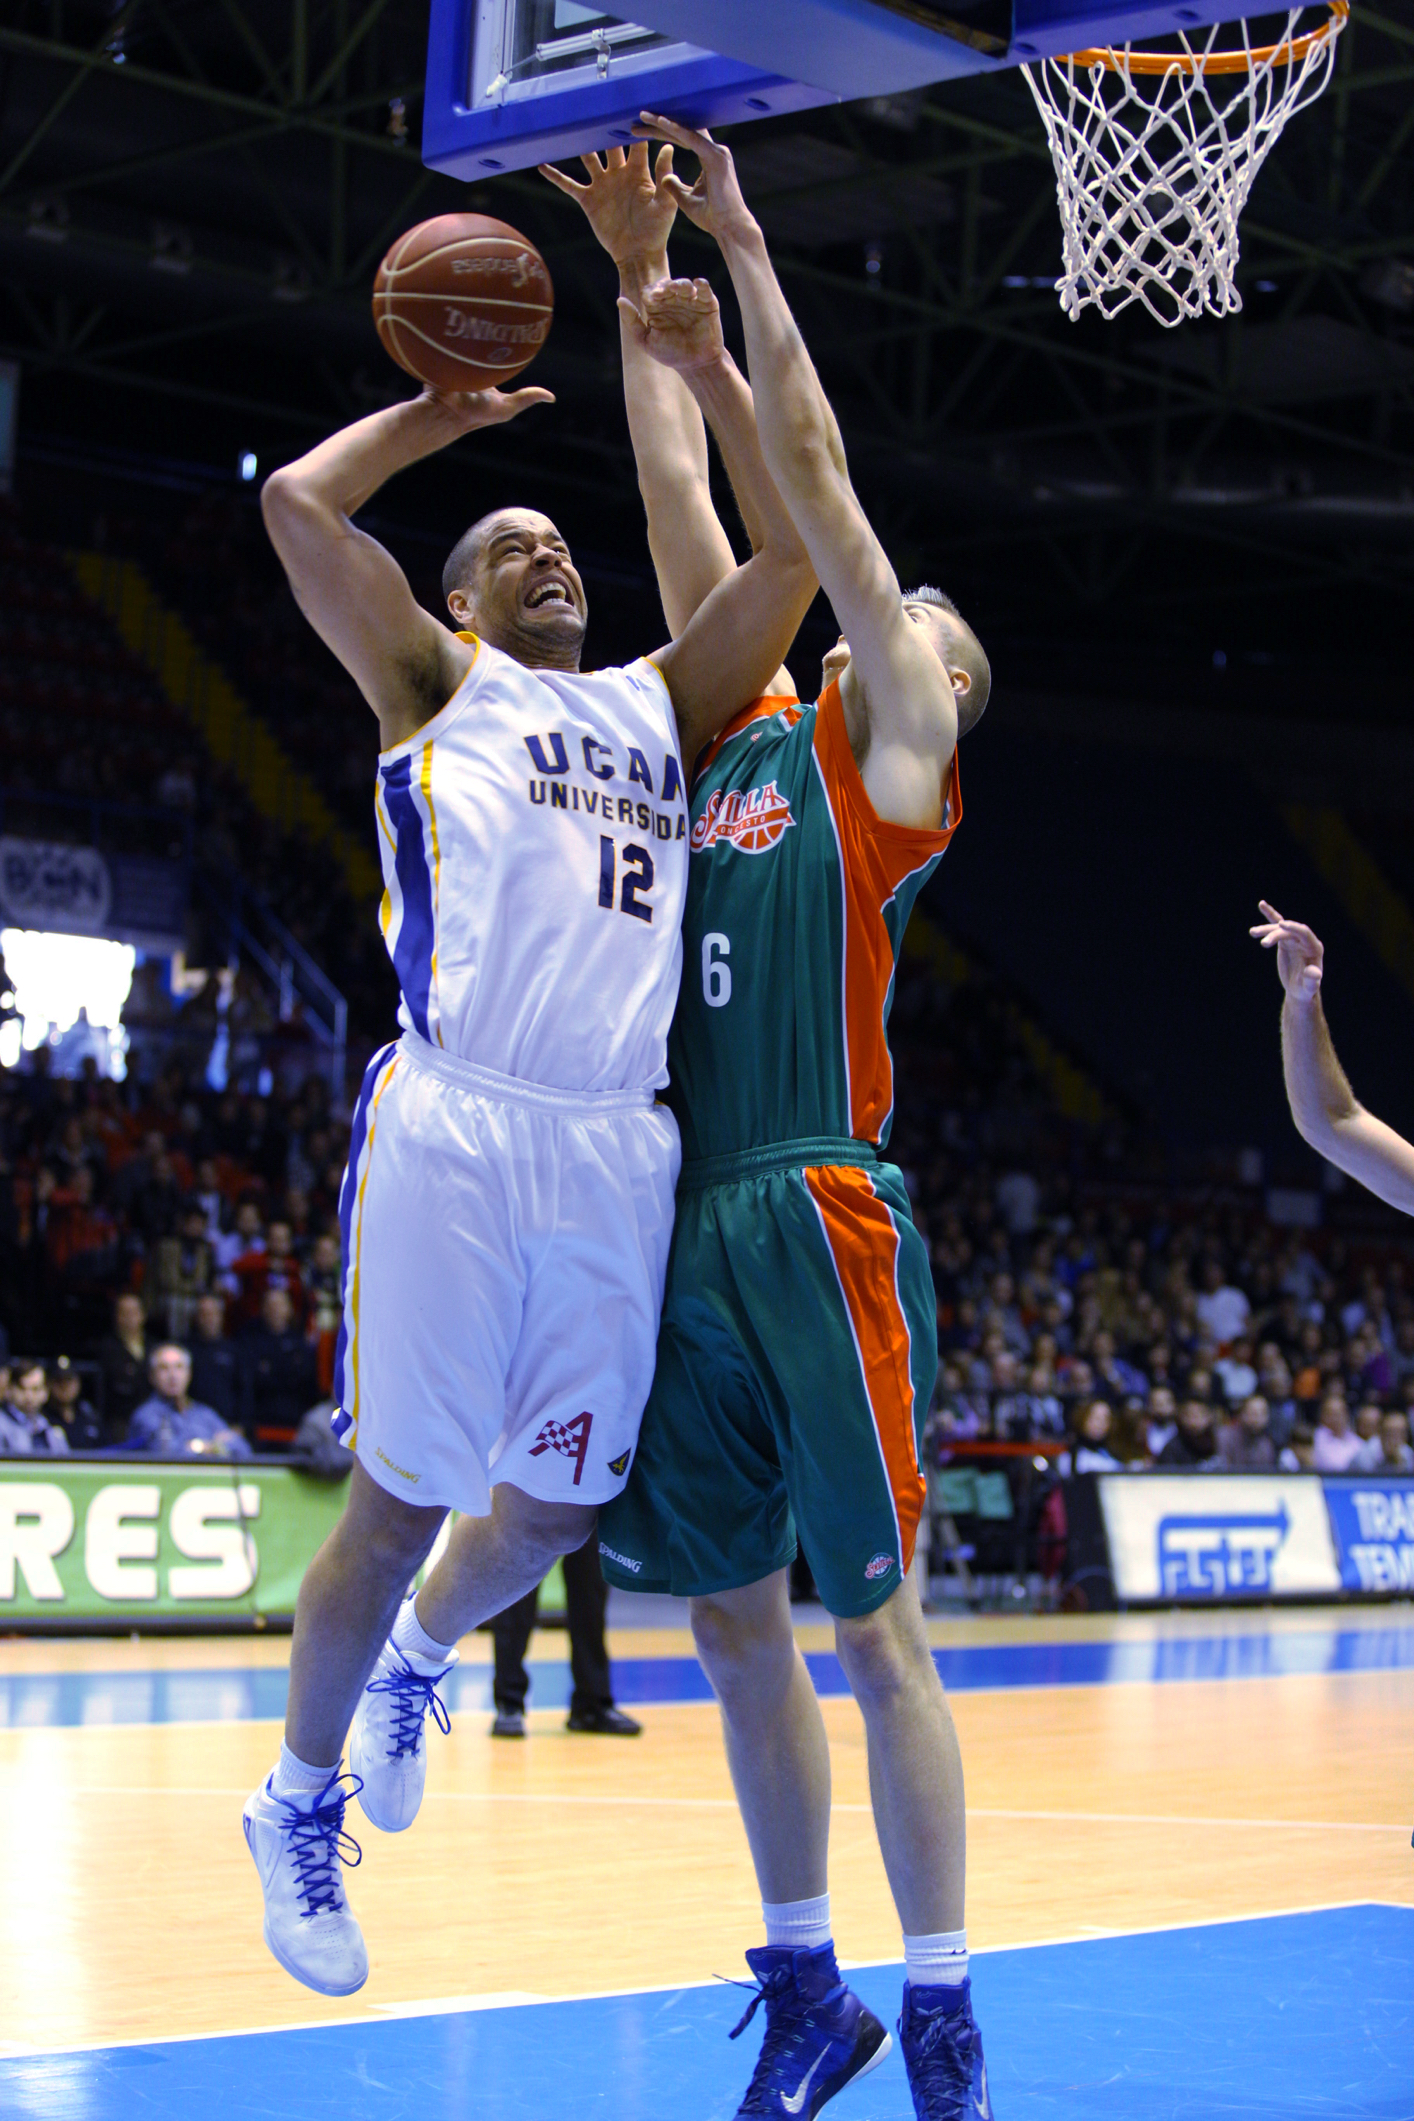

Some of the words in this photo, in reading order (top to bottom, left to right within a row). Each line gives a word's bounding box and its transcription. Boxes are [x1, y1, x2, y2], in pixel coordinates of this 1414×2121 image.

[597, 834, 655, 924] 12
[701, 932, 732, 1008] 6
[374, 1447, 421, 1484] SPALDING
[0, 1482, 261, 1601] RES
[1351, 1491, 1414, 1542] TRA
[598, 1542, 643, 1574] SPALDING
